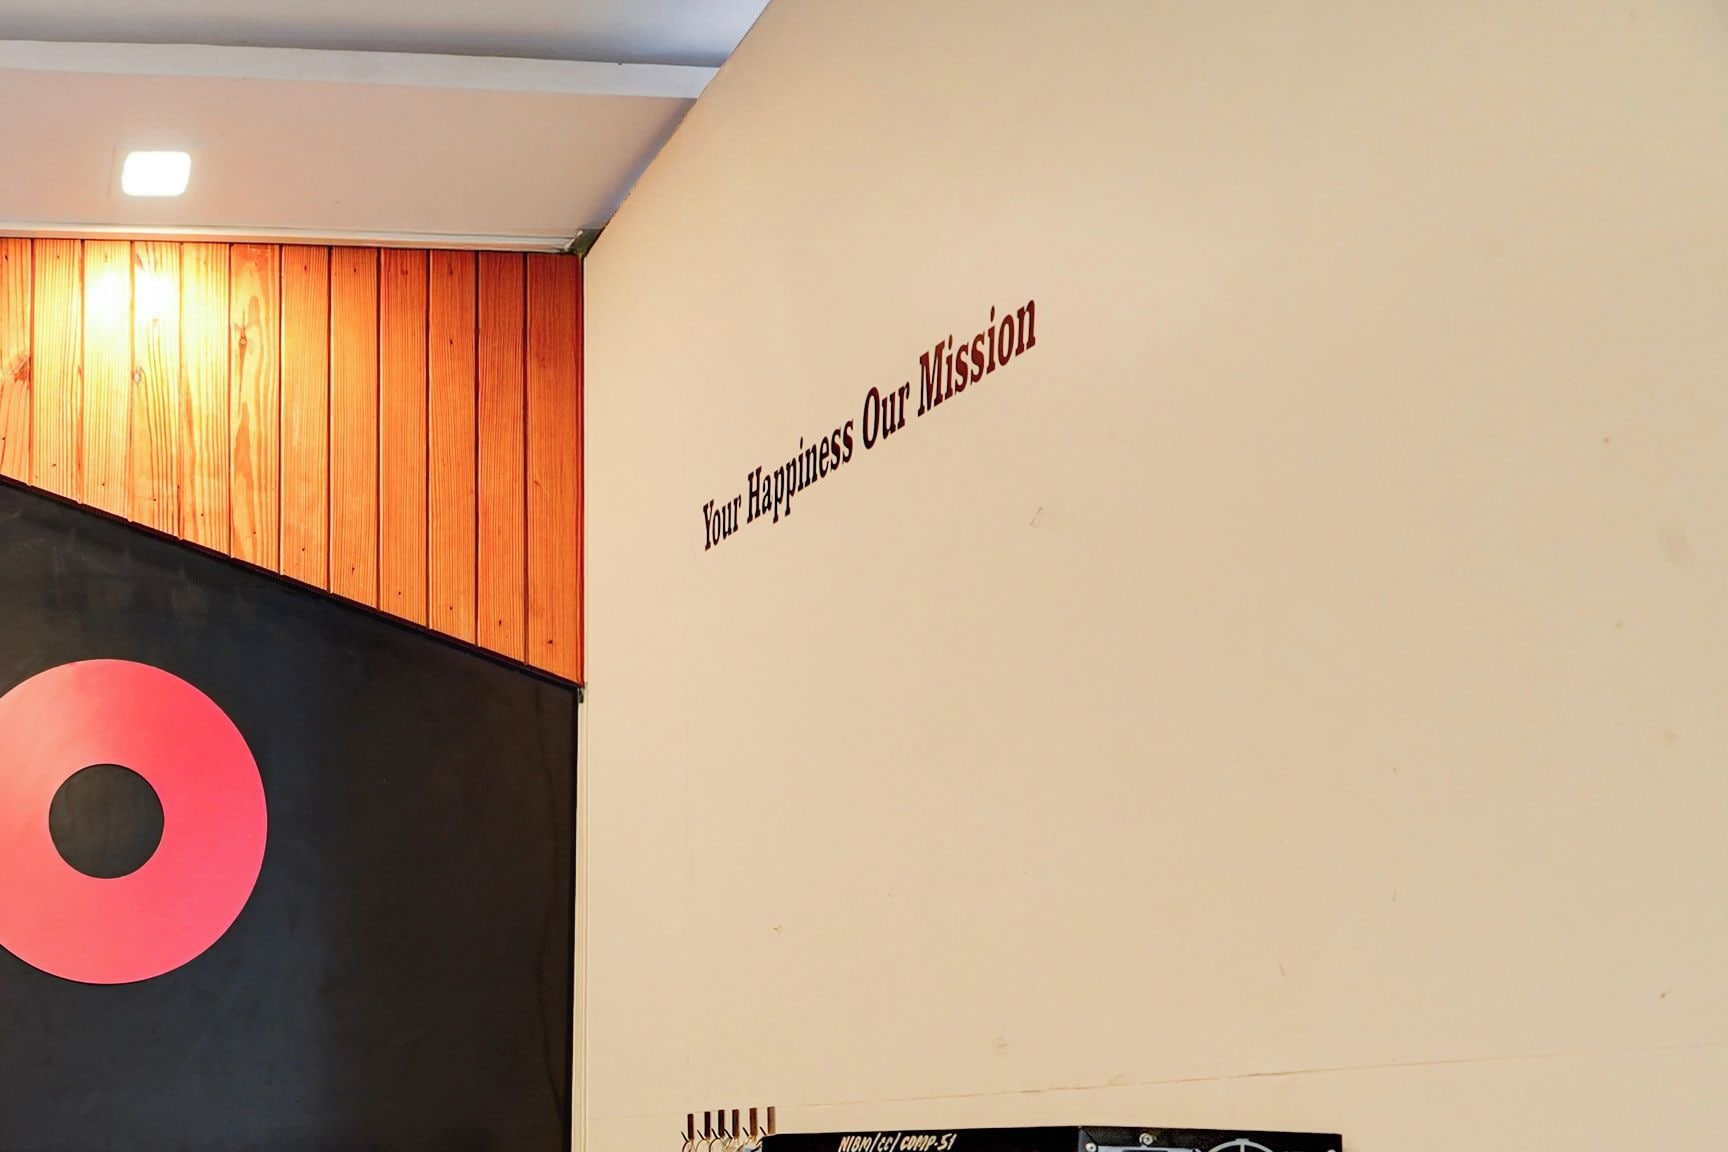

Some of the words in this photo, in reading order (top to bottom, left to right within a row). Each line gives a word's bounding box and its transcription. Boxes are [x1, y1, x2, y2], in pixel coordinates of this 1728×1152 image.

[702, 494, 742, 551] Your
[746, 418, 854, 524] Happiness
[862, 381, 911, 450] Our
[917, 299, 1036, 418] Mission
